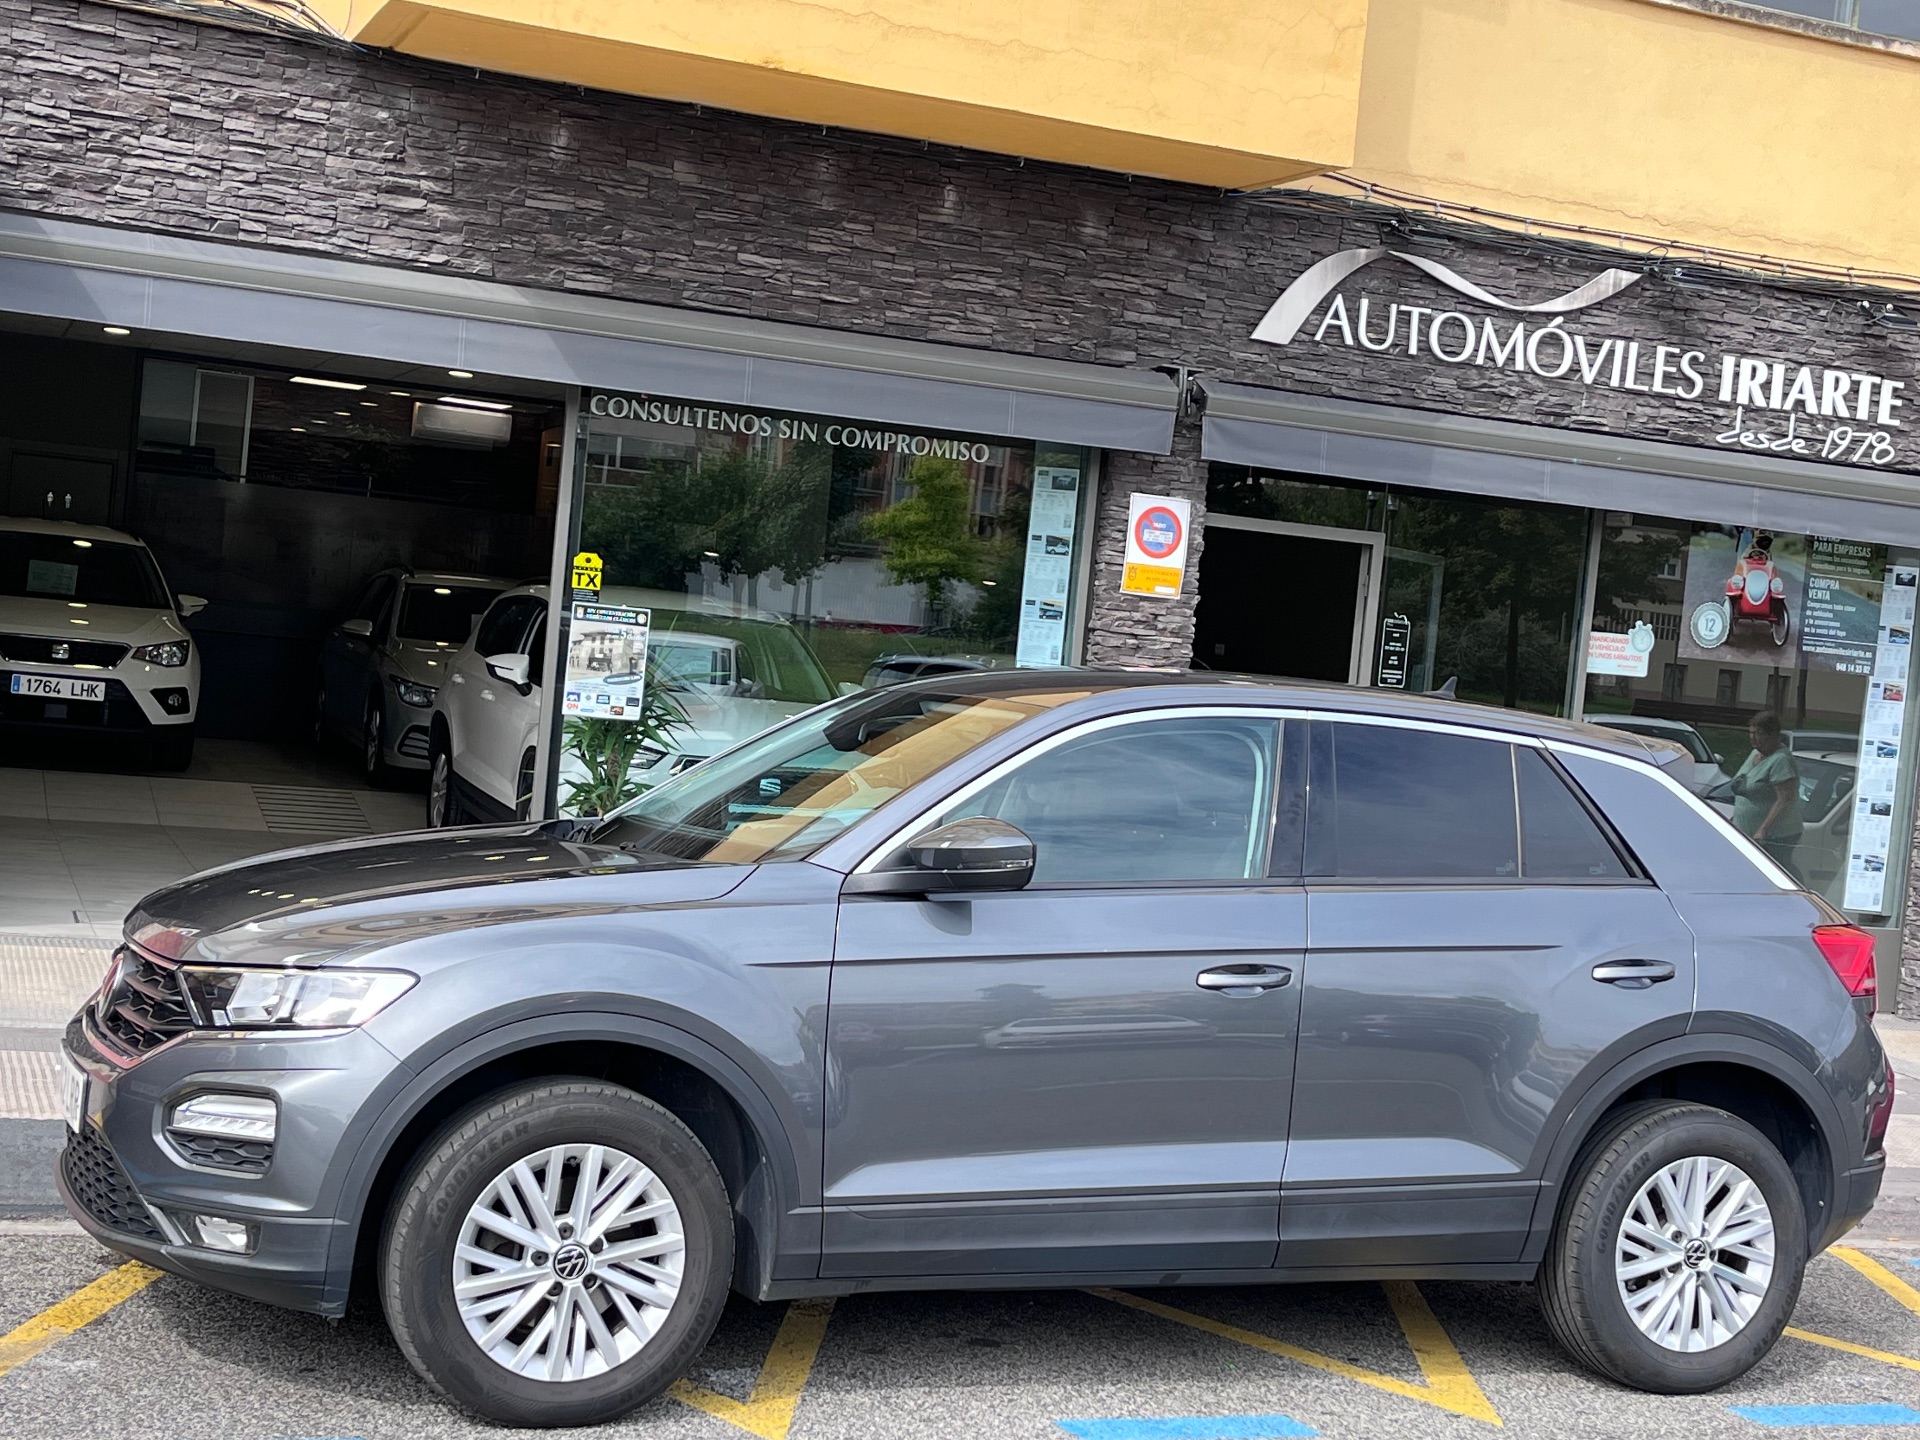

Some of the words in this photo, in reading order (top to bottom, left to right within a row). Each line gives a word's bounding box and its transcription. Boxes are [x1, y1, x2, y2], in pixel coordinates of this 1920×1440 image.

[1314, 293, 1706, 399] AUTOMÓVILES
[1718, 354, 1906, 428] IRIARTE
[589, 394, 772, 438] CONSULTENOS
[778, 418, 819, 443] SIN
[824, 424, 990, 464] COMPROMISO
[1715, 405, 1809, 454] desde
[1820, 425, 1897, 466] 1978
[1813, 541, 1832, 553] PARA
[1833, 543, 1872, 558] EMPRESAS
[574, 571, 599, 589] TX
[1809, 577, 1840, 591] COMPRA
[1808, 588, 1831, 601] VENTA
[1704, 617, 1716, 633] 12
[26, 677, 62, 696] 1764
[71, 681, 100, 699] LHK
